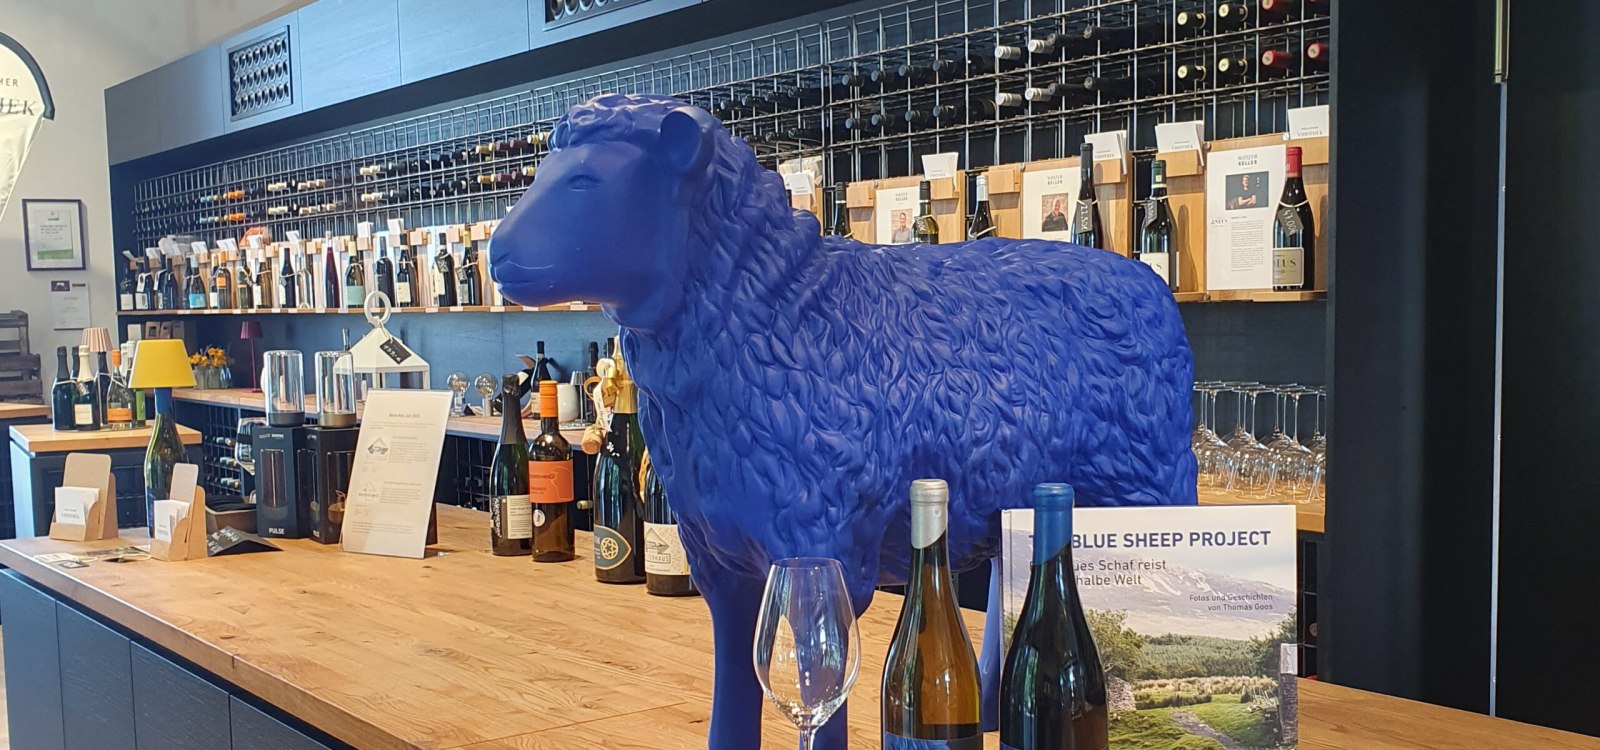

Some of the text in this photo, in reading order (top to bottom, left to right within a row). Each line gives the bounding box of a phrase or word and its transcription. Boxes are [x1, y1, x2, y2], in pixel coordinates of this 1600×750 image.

[268, 527, 285, 535] PULSE
[1072, 530, 1272, 549] BLUE SHEEP PROJECT
[1098, 559, 1136, 571] Schaf
[1138, 559, 1167, 571] reist
[1114, 574, 1142, 586] Welt
[1189, 593, 1273, 602] Fotos und Geschichten
[1223, 603, 1253, 611] Thomas
